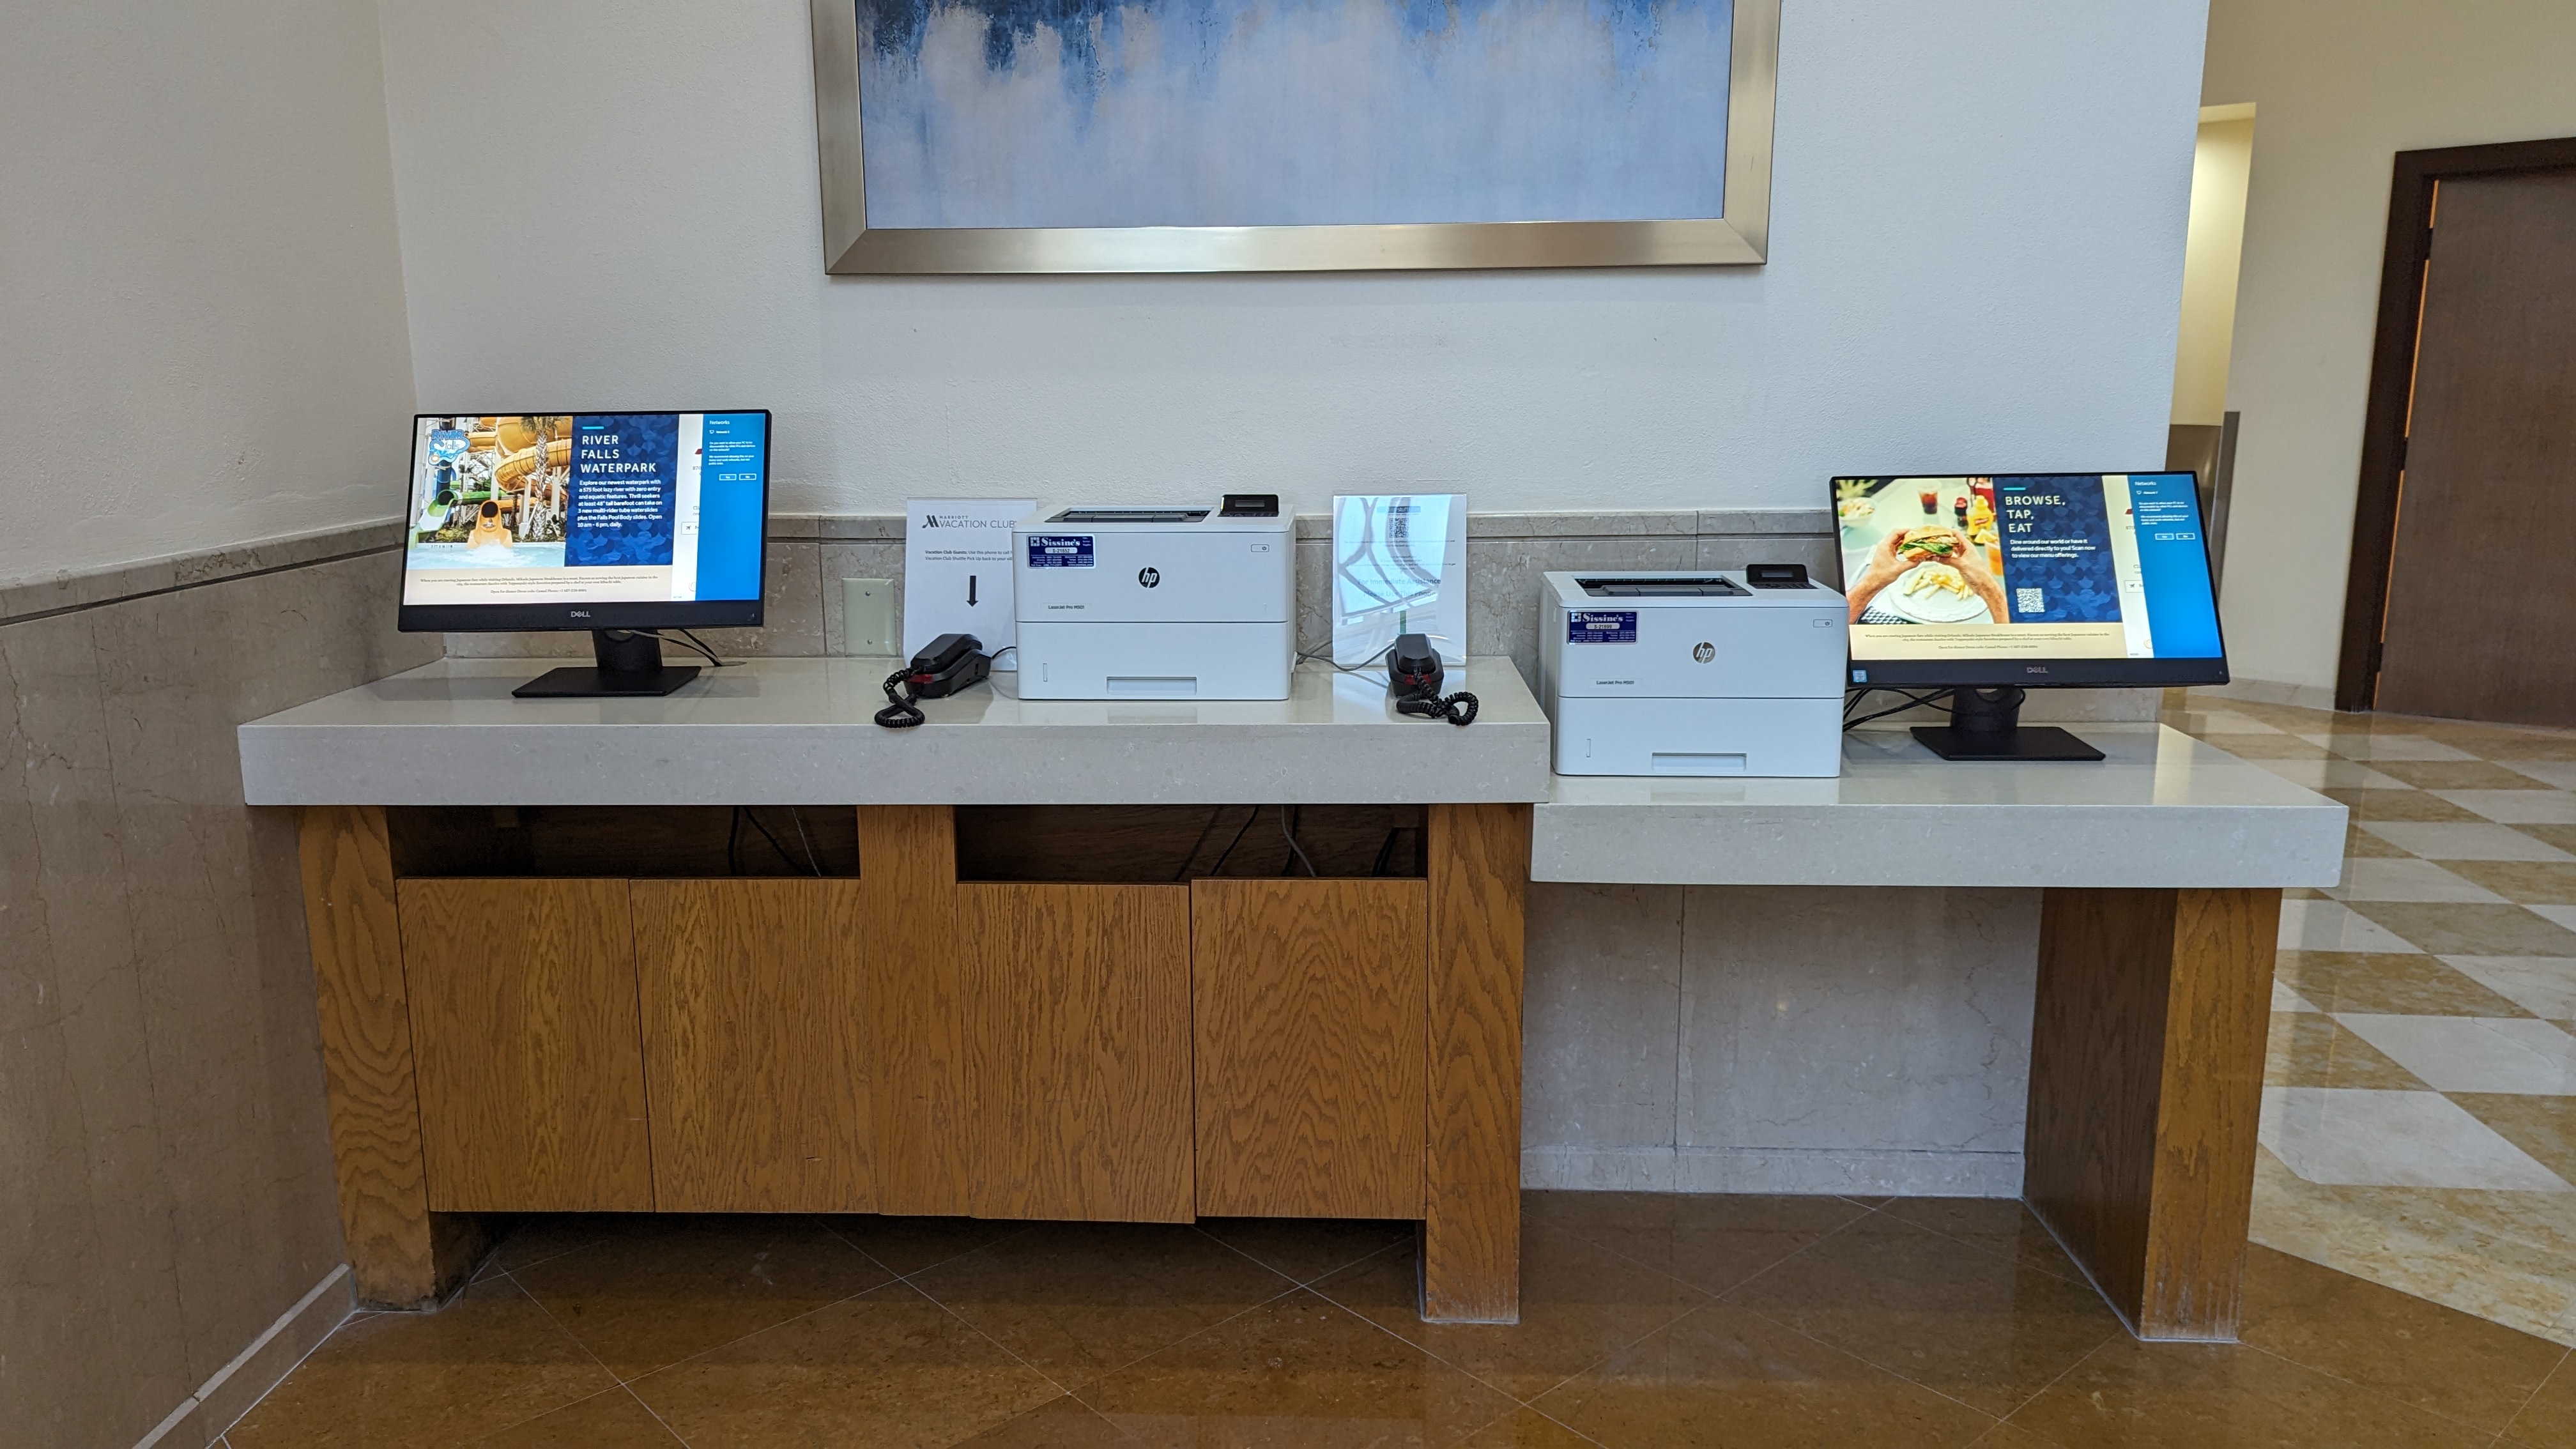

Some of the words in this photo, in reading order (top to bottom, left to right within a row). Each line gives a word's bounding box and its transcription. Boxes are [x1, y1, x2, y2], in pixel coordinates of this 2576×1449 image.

[582, 435, 618, 445] RIVER
[581, 449, 620, 459] FALLS
[580, 463, 656, 473] WATERPARK
[2005, 495, 2066, 505] BROWSE,
[2007, 510, 2034, 519] TAP,
[939, 520, 987, 528] VACATION
[2009, 523, 2033, 533] EAT
[1041, 537, 1080, 546] Sissine's
[1140, 567, 1158, 588] hp
[1583, 613, 1623, 622] Sissine's
[1695, 641, 1713, 664] hp
